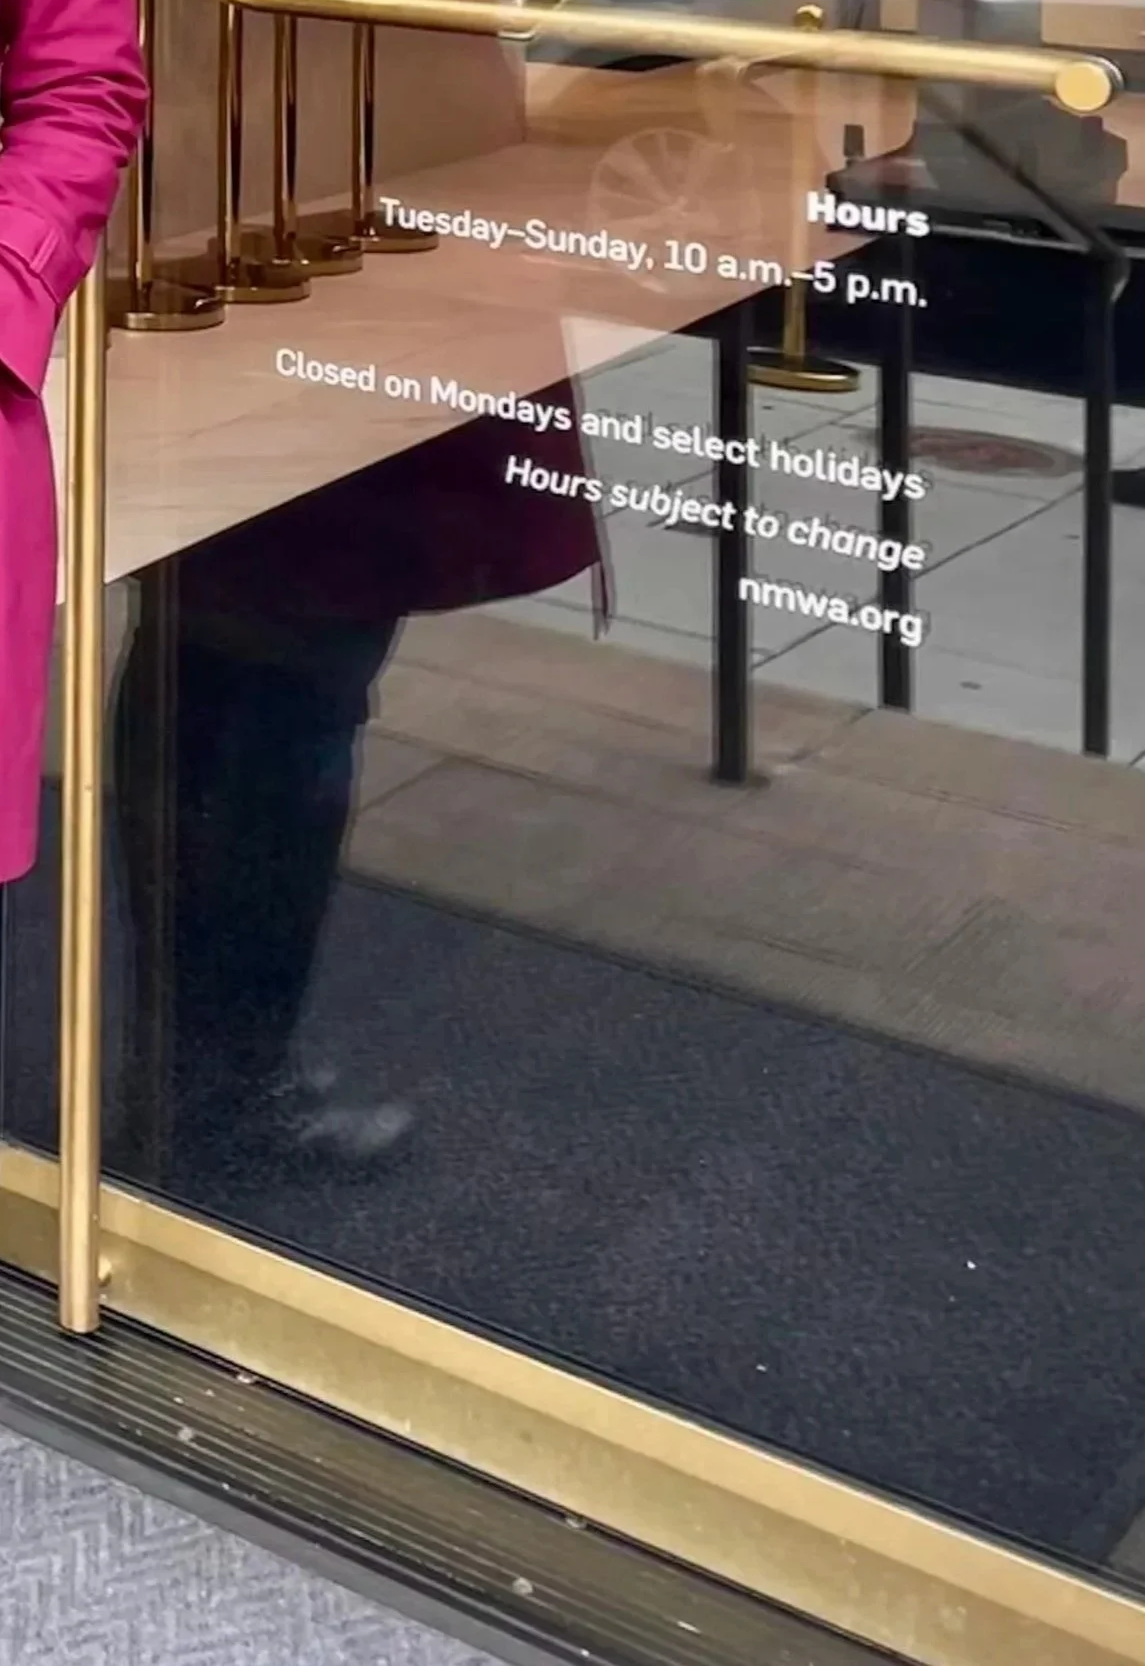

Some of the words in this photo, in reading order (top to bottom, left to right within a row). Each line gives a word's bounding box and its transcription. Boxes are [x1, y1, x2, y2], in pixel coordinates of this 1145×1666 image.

[806, 190, 930, 237] Hours
[663, 239, 708, 274] 10
[847, 273, 928, 308] p.m.
[275, 348, 376, 393] Closed
[383, 374, 422, 402] on
[429, 375, 573, 433] Mondays
[580, 412, 643, 445] and
[652, 423, 761, 469] select
[769, 440, 926, 501] holidays
[505, 455, 603, 502] Hours
[609, 483, 737, 530] subject
[743, 505, 780, 539] to
[786, 516, 926, 572] change
[739, 577, 924, 648] nmwa.org
